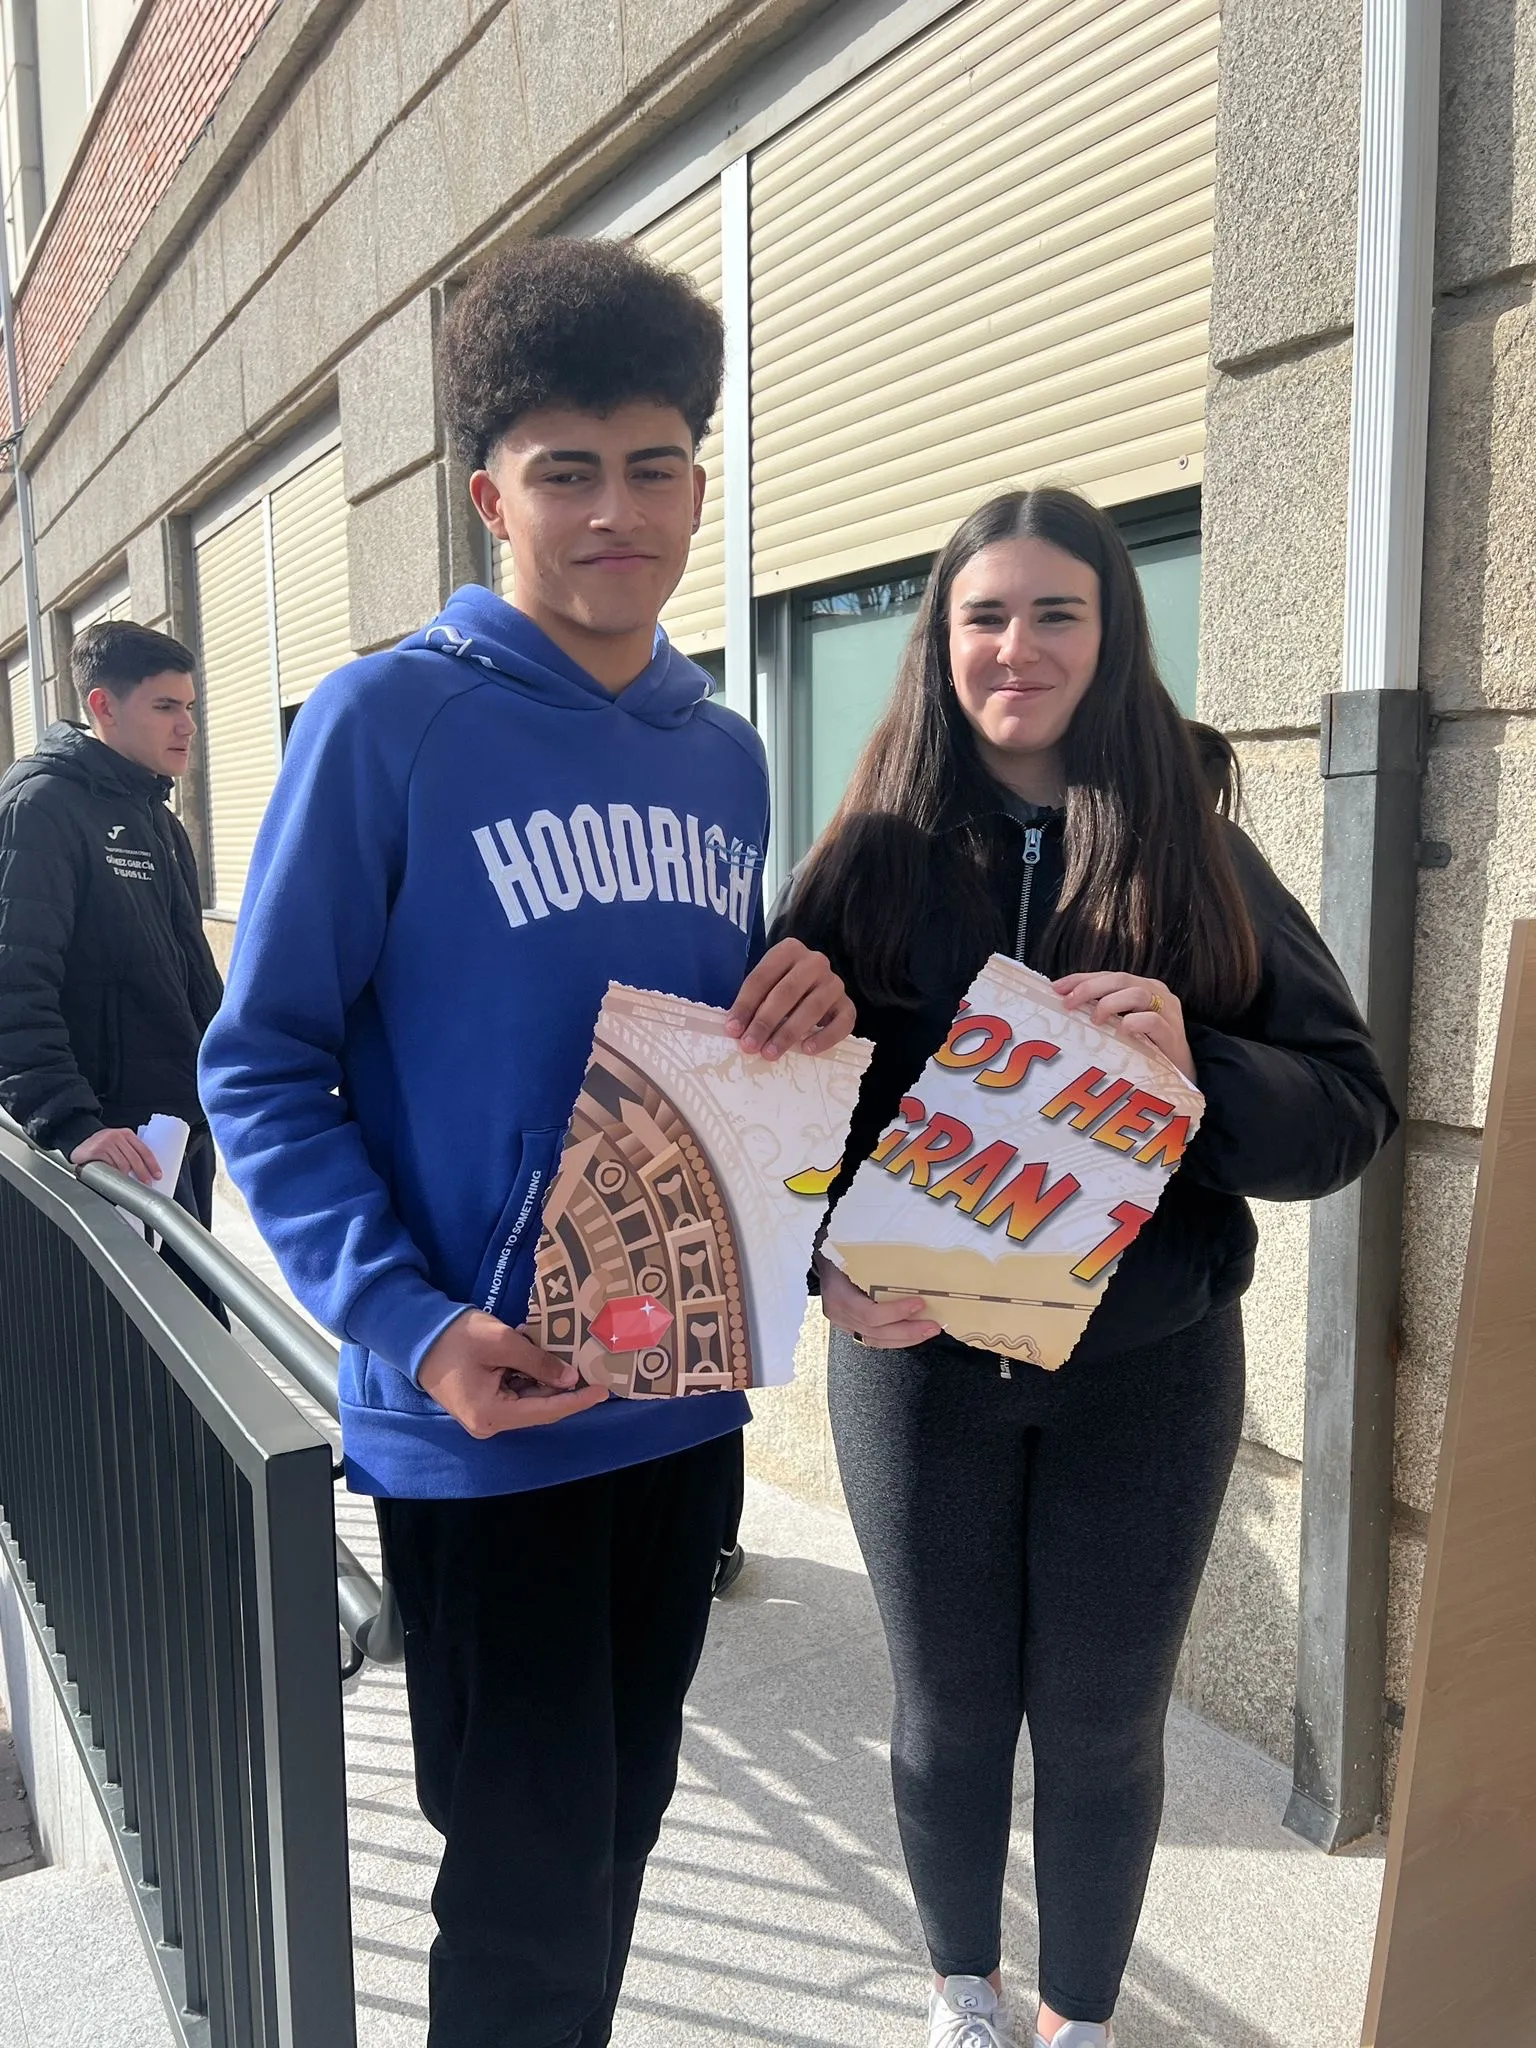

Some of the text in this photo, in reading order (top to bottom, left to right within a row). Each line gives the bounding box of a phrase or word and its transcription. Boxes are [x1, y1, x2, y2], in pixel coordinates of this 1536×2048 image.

[471, 803, 758, 934] HOODRICH
[932, 1000, 1062, 1089] OS
[482, 1169, 542, 1314] OM NOTHING TO SOMETHING
